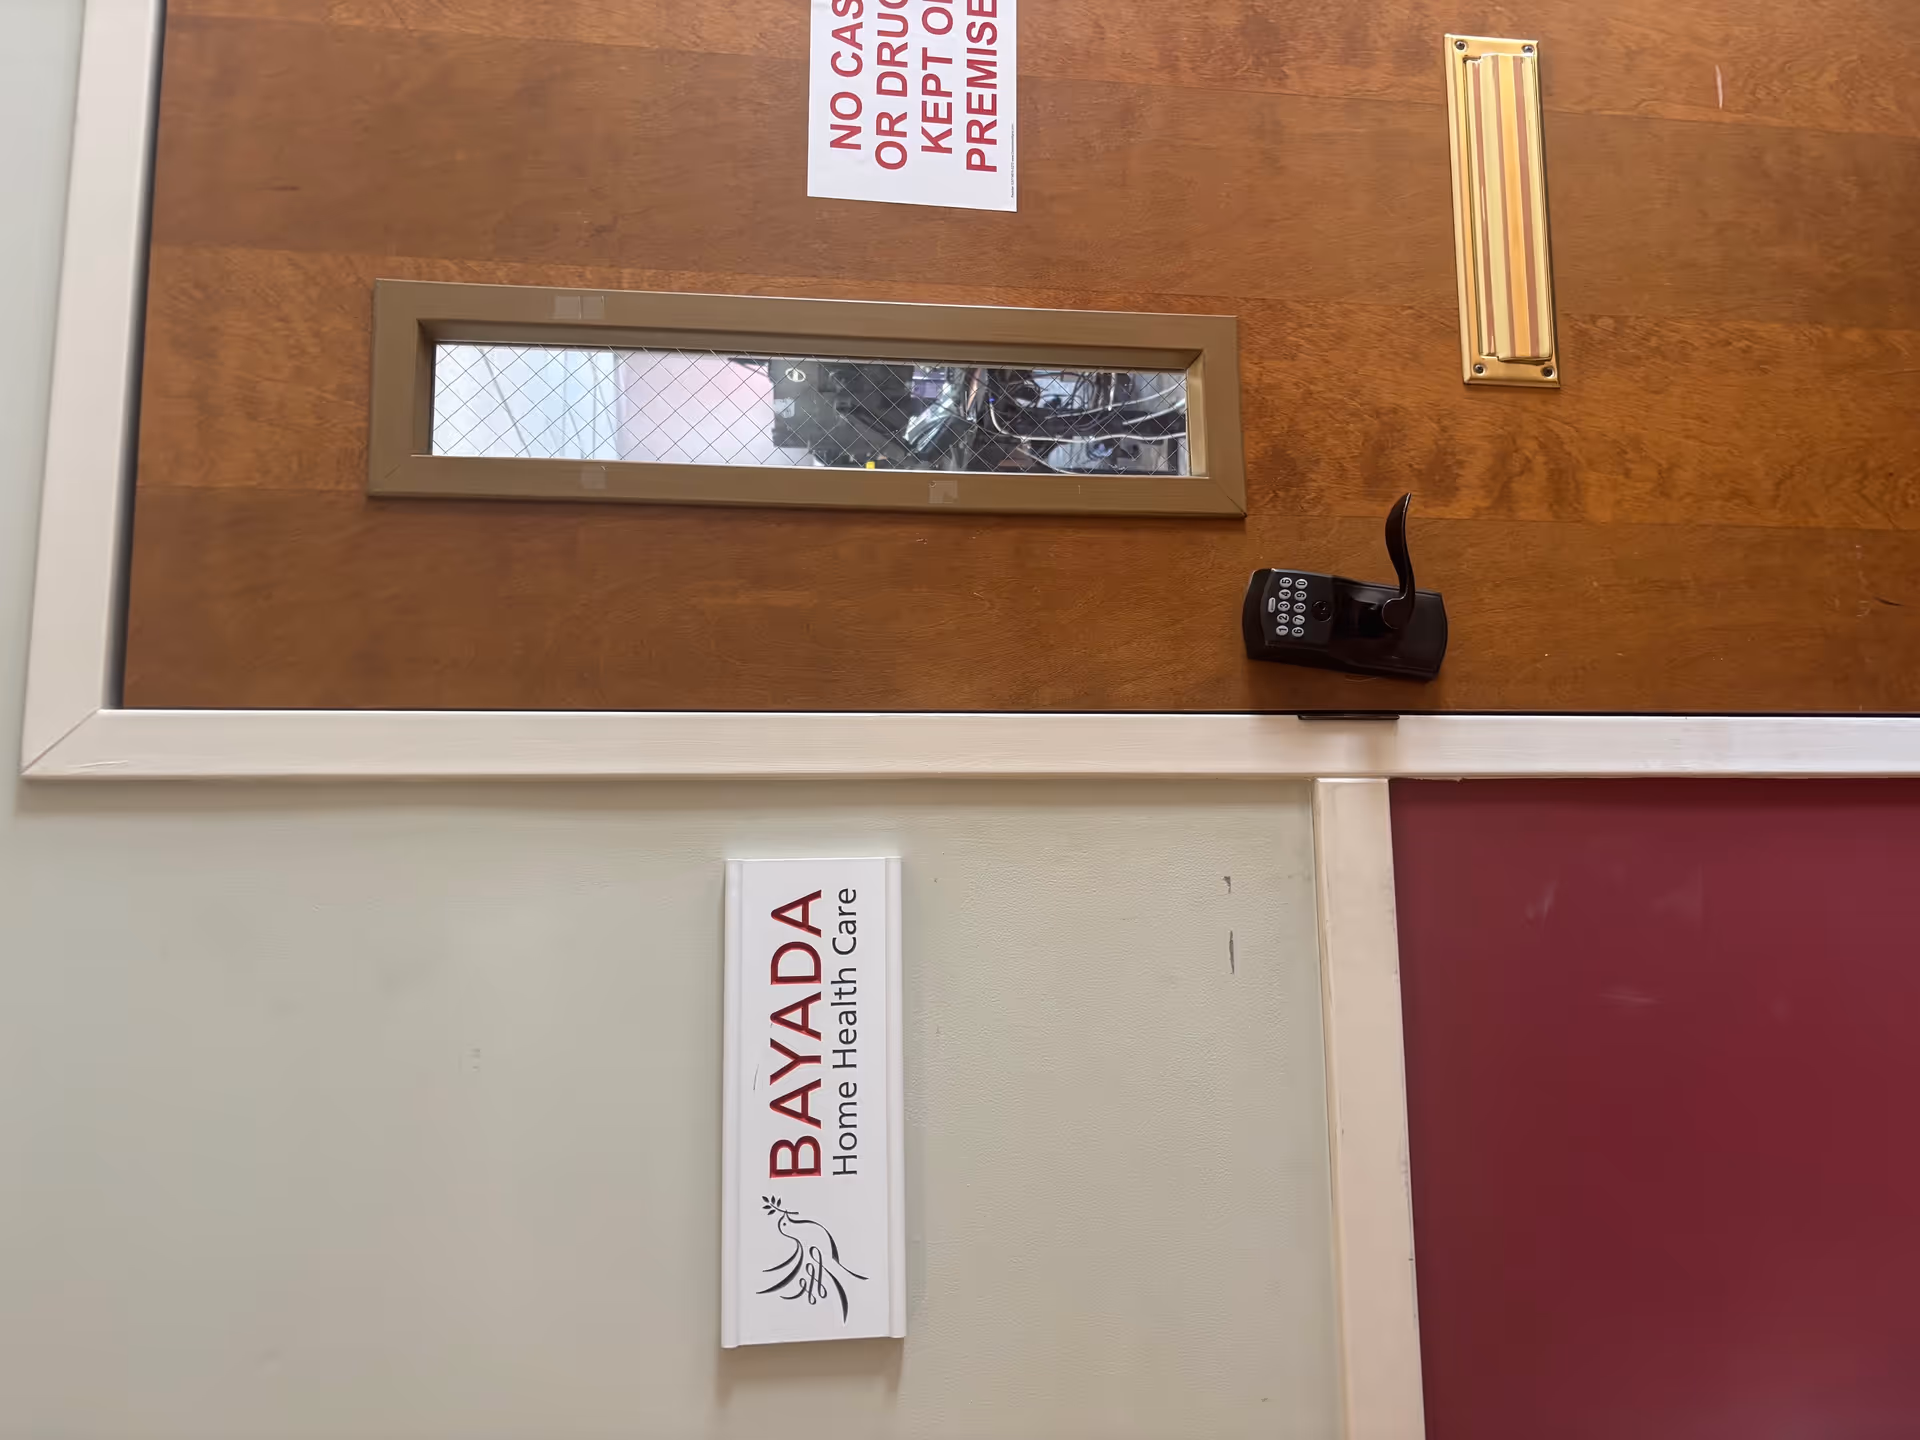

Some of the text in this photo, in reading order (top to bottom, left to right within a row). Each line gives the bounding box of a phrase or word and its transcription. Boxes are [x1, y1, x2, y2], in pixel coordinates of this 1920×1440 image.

[830, 91, 863, 150] NO
[875, 112, 908, 170] OR
[921, 0, 953, 154] KEPT O
[769, 889, 822, 1178] BAYADA
[830, 888, 857, 1175] Home Health Care
